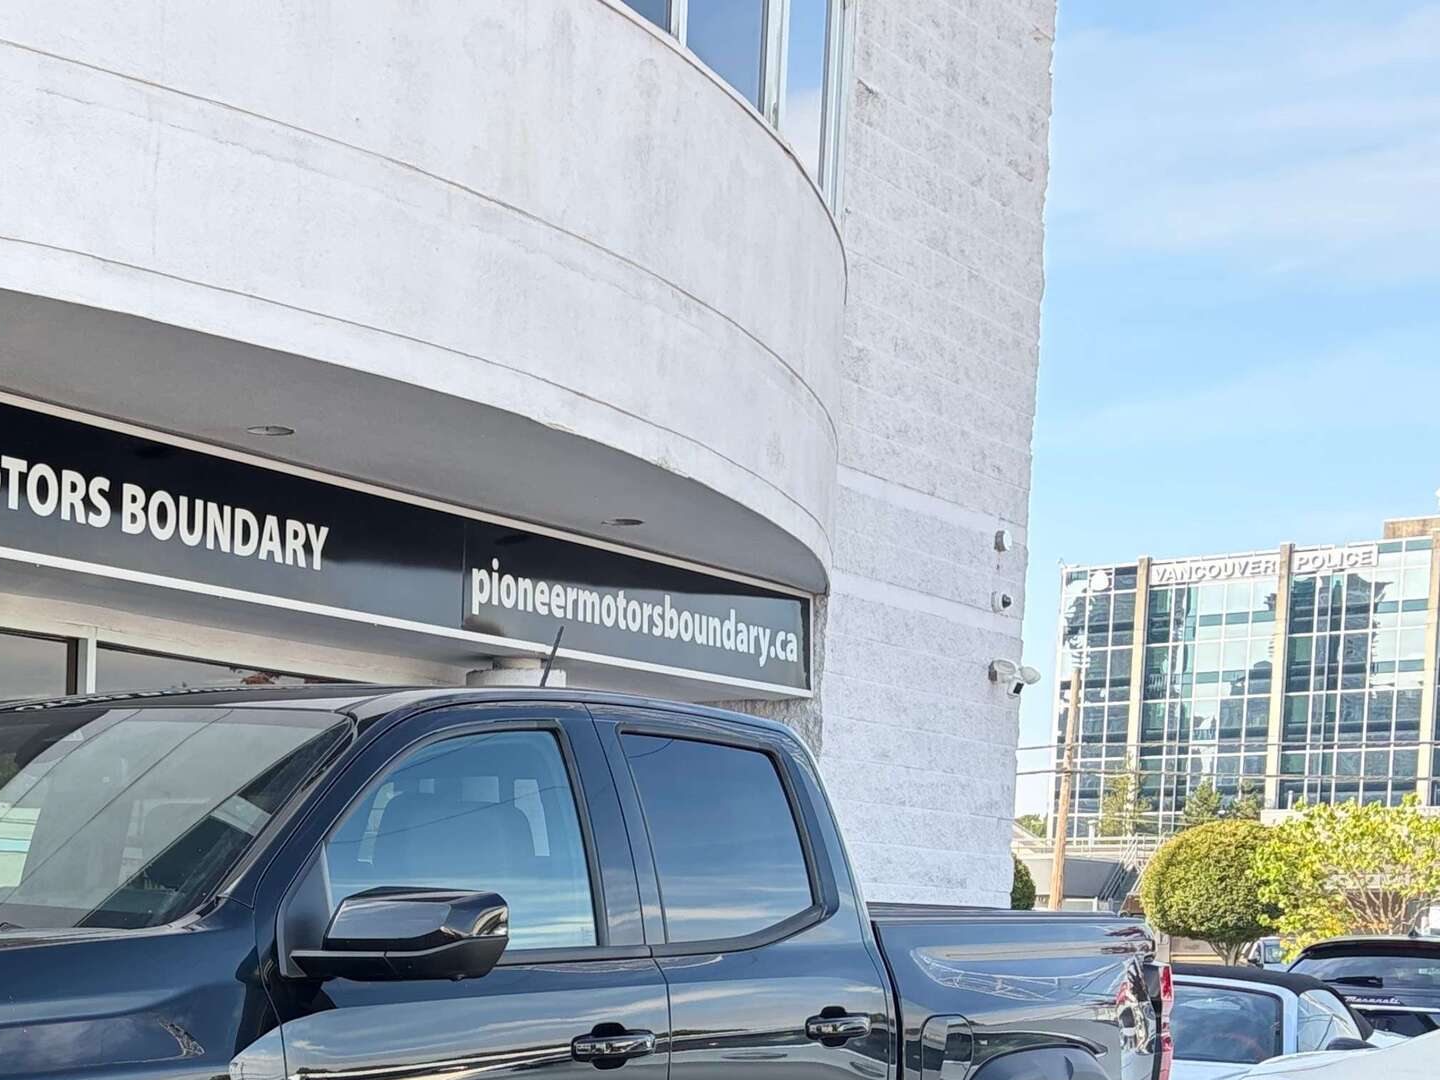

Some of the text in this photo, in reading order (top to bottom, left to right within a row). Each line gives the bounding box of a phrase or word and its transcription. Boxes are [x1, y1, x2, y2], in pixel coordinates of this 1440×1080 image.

[120, 482, 329, 571] BOUNDARY
[1155, 549, 1373, 582] VANCOUVER POLICE
[471, 557, 798, 667] pioneermotorsboundary.ca
